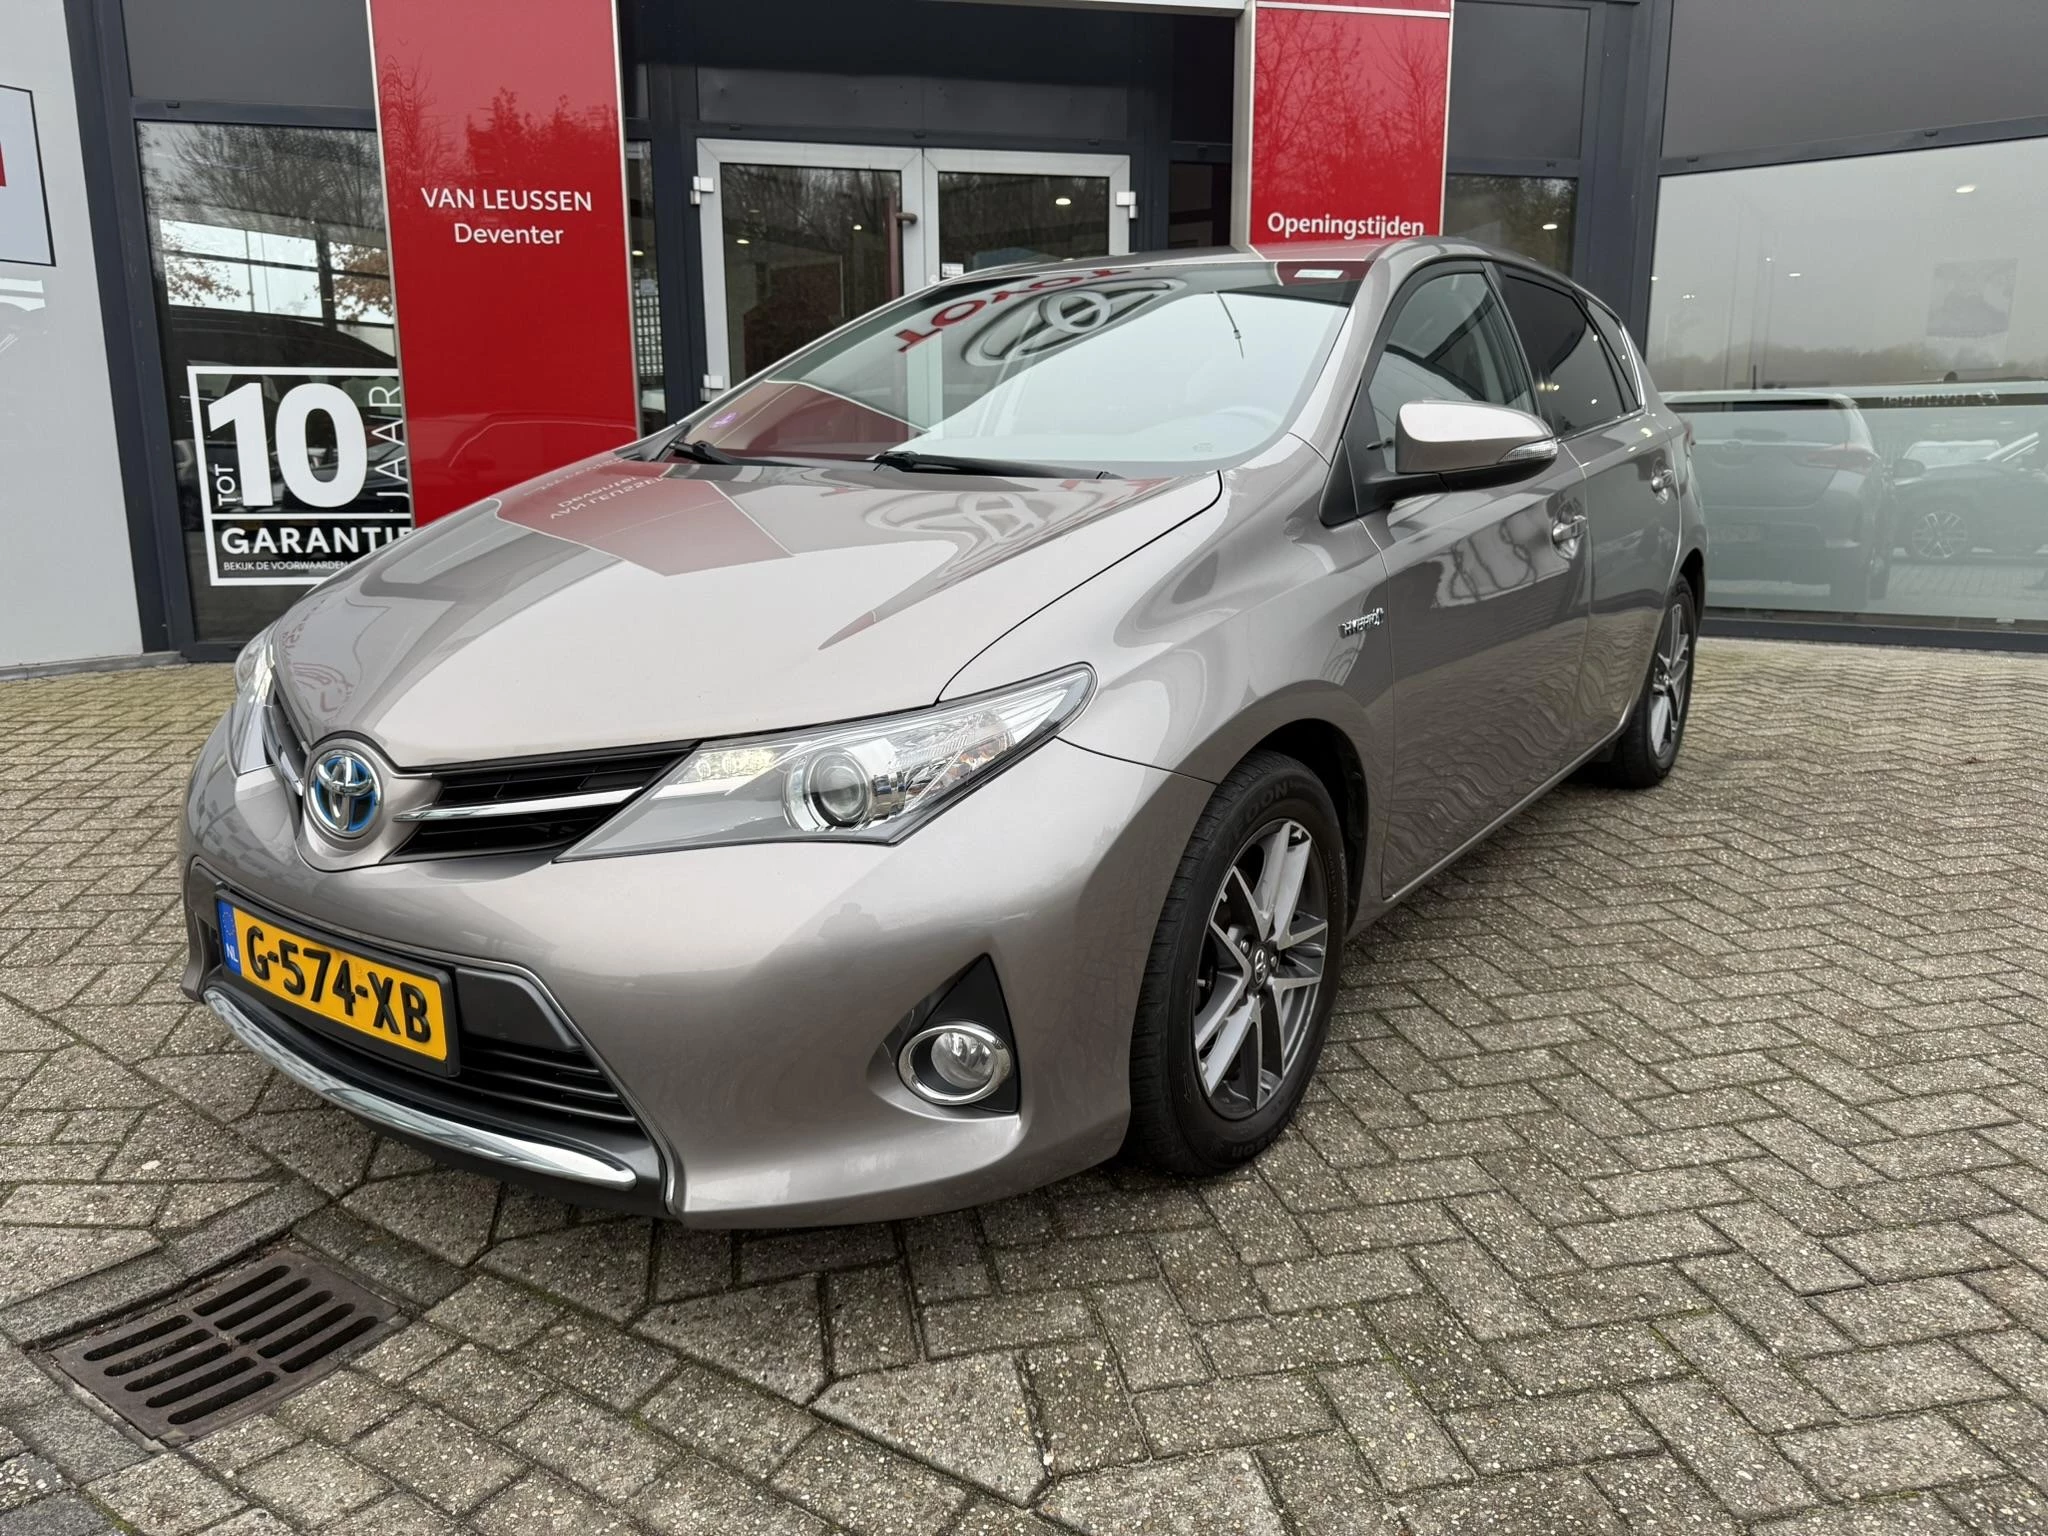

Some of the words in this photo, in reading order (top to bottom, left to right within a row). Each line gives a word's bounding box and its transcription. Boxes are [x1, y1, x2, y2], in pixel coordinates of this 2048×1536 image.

[420, 187, 475, 209] VAN
[482, 189, 592, 212] LEUSSEN
[454, 223, 564, 245] Deventer
[1267, 212, 1425, 240] Openingstijden
[208, 382, 368, 508] 10
[368, 386, 411, 499] JAAR
[214, 464, 238, 506] TOT
[223, 562, 255, 571] BEKIJK
[256, 562, 269, 571] DE
[271, 561, 349, 571] VOORWAARDEN
[226, 943, 239, 963] NL
[246, 925, 432, 1044] G-574-XB
